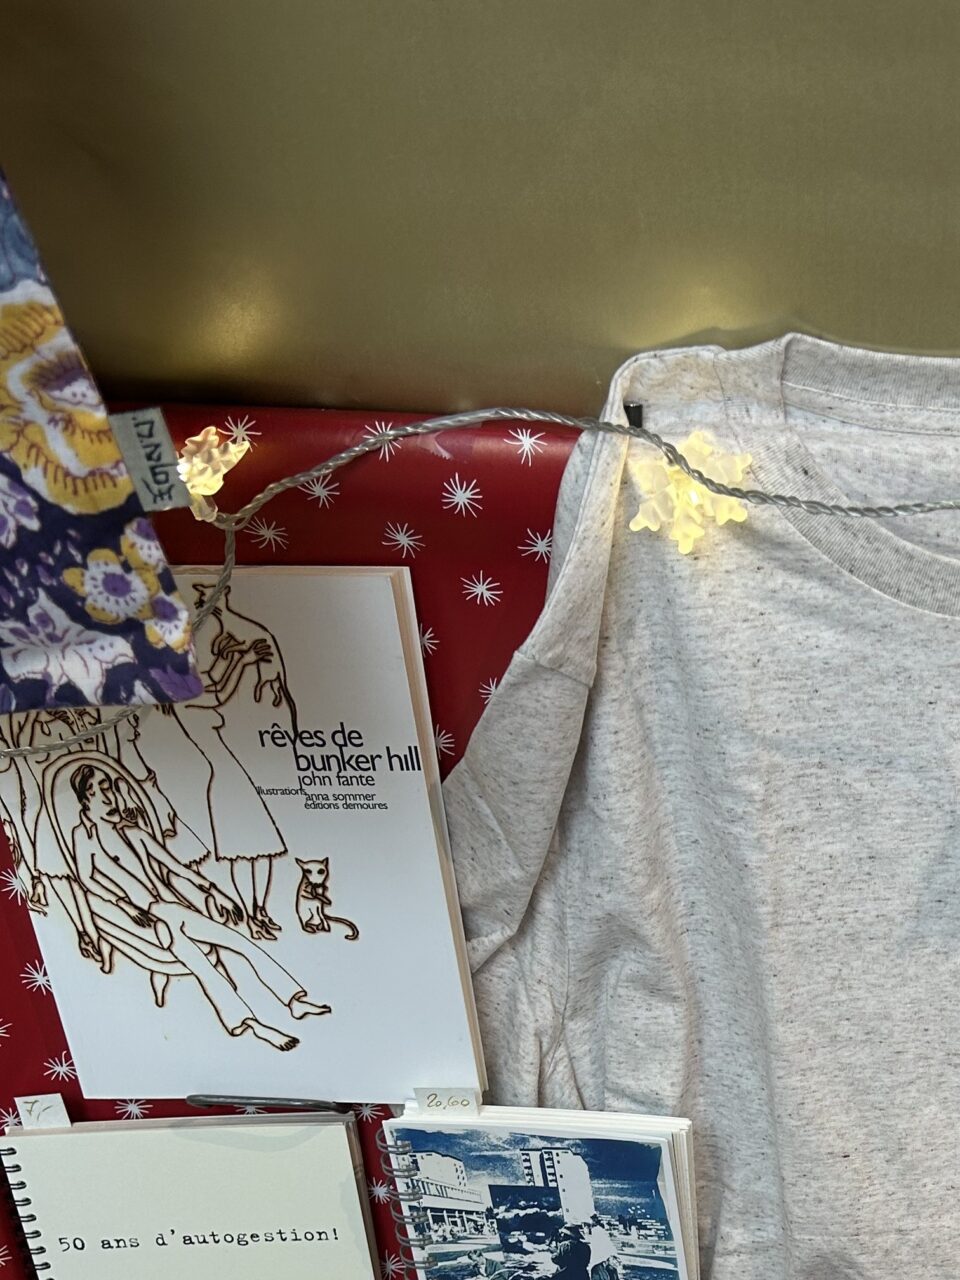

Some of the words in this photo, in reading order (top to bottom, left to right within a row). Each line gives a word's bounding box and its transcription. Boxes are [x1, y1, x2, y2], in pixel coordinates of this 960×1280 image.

[258, 723, 326, 748] rêves
[331, 722, 364, 748] de
[296, 746, 382, 771] bunker
[385, 745, 421, 771] hill
[298, 771, 332, 791] john
[336, 770, 375, 786] fante
[304, 800, 340, 810] éditions
[342, 800, 388, 810] demoures
[305, 793, 330, 801] anna
[332, 793, 376, 801] sommer
[59, 1237, 86, 1252] 50
[101, 1236, 140, 1250] ans
[155, 1228, 338, 1246] d'autogestion!
